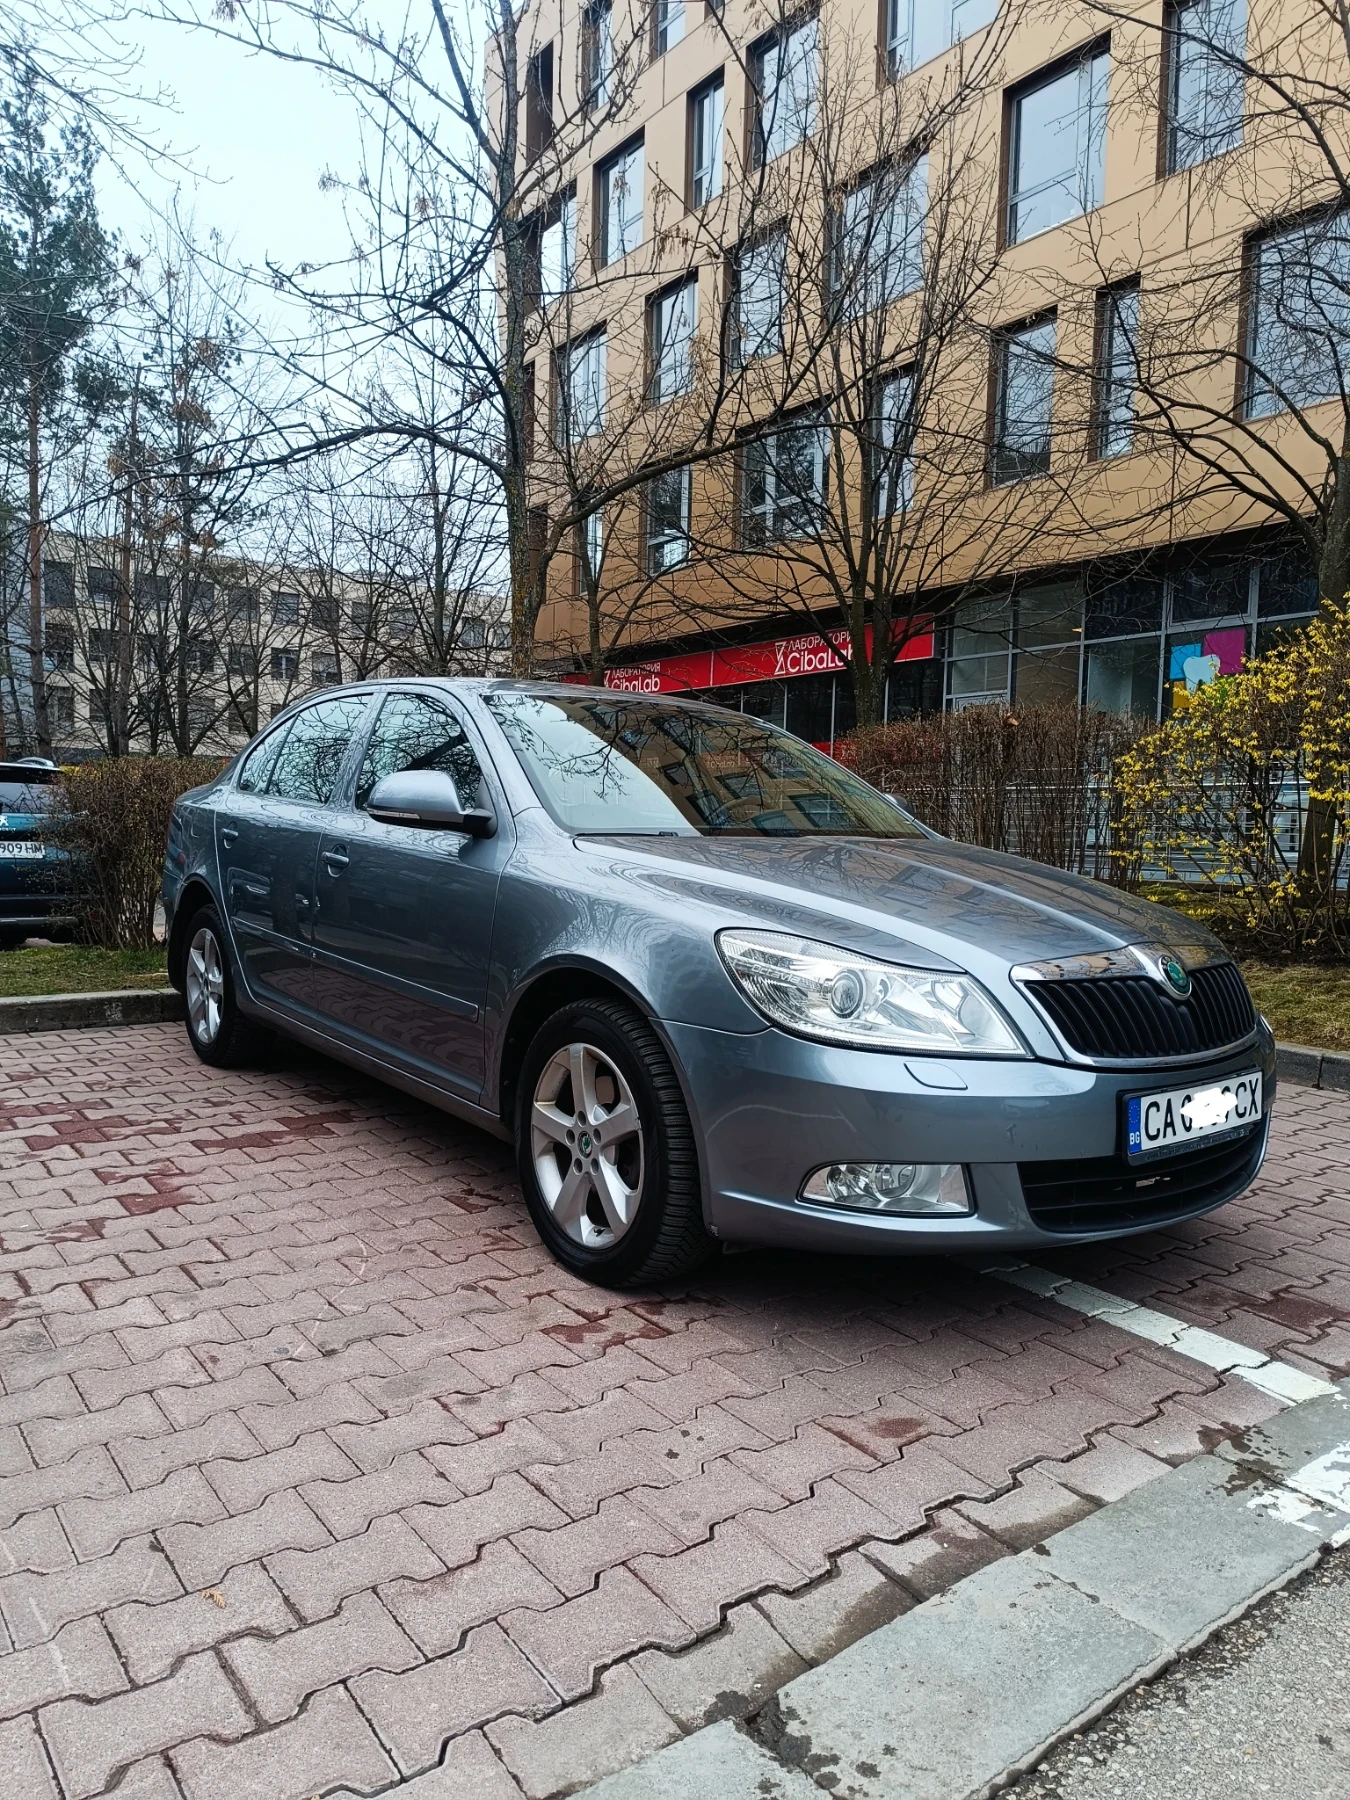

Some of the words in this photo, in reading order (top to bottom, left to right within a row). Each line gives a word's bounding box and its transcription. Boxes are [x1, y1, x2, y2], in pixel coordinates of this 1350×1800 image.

[787, 631, 851, 652] ЛАБОРАОРИ
[611, 674, 661, 692] CibaLab
[1129, 1132, 1140, 1145] BG
[1144, 1097, 1177, 1141] CA
